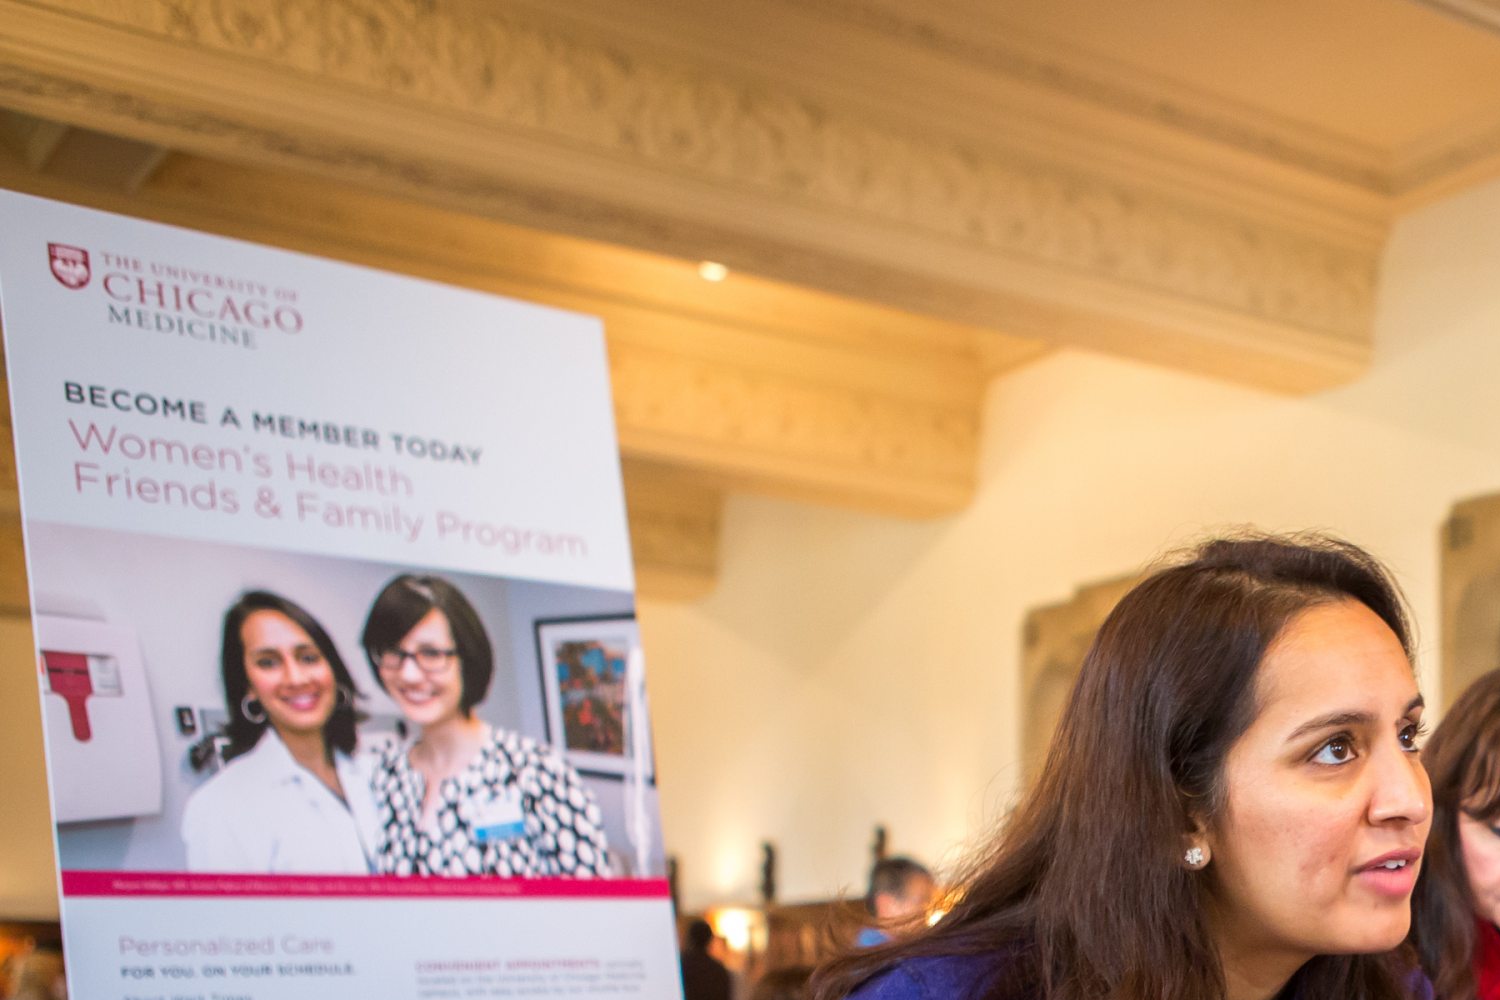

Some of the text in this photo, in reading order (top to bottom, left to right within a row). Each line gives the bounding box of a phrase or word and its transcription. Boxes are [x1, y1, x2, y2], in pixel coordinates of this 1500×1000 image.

[102, 252, 142, 271] THE
[151, 262, 268, 296] UNIVERSITY
[103, 272, 304, 334] CHICAGO
[108, 304, 257, 349] MEDICINE
[64, 381, 483, 465] BECOME A MEMBER TODAY
[68, 418, 414, 496] Women's Health
[74, 461, 588, 557] Friends & Family Program
[118, 934, 335, 957] Personalized Care
